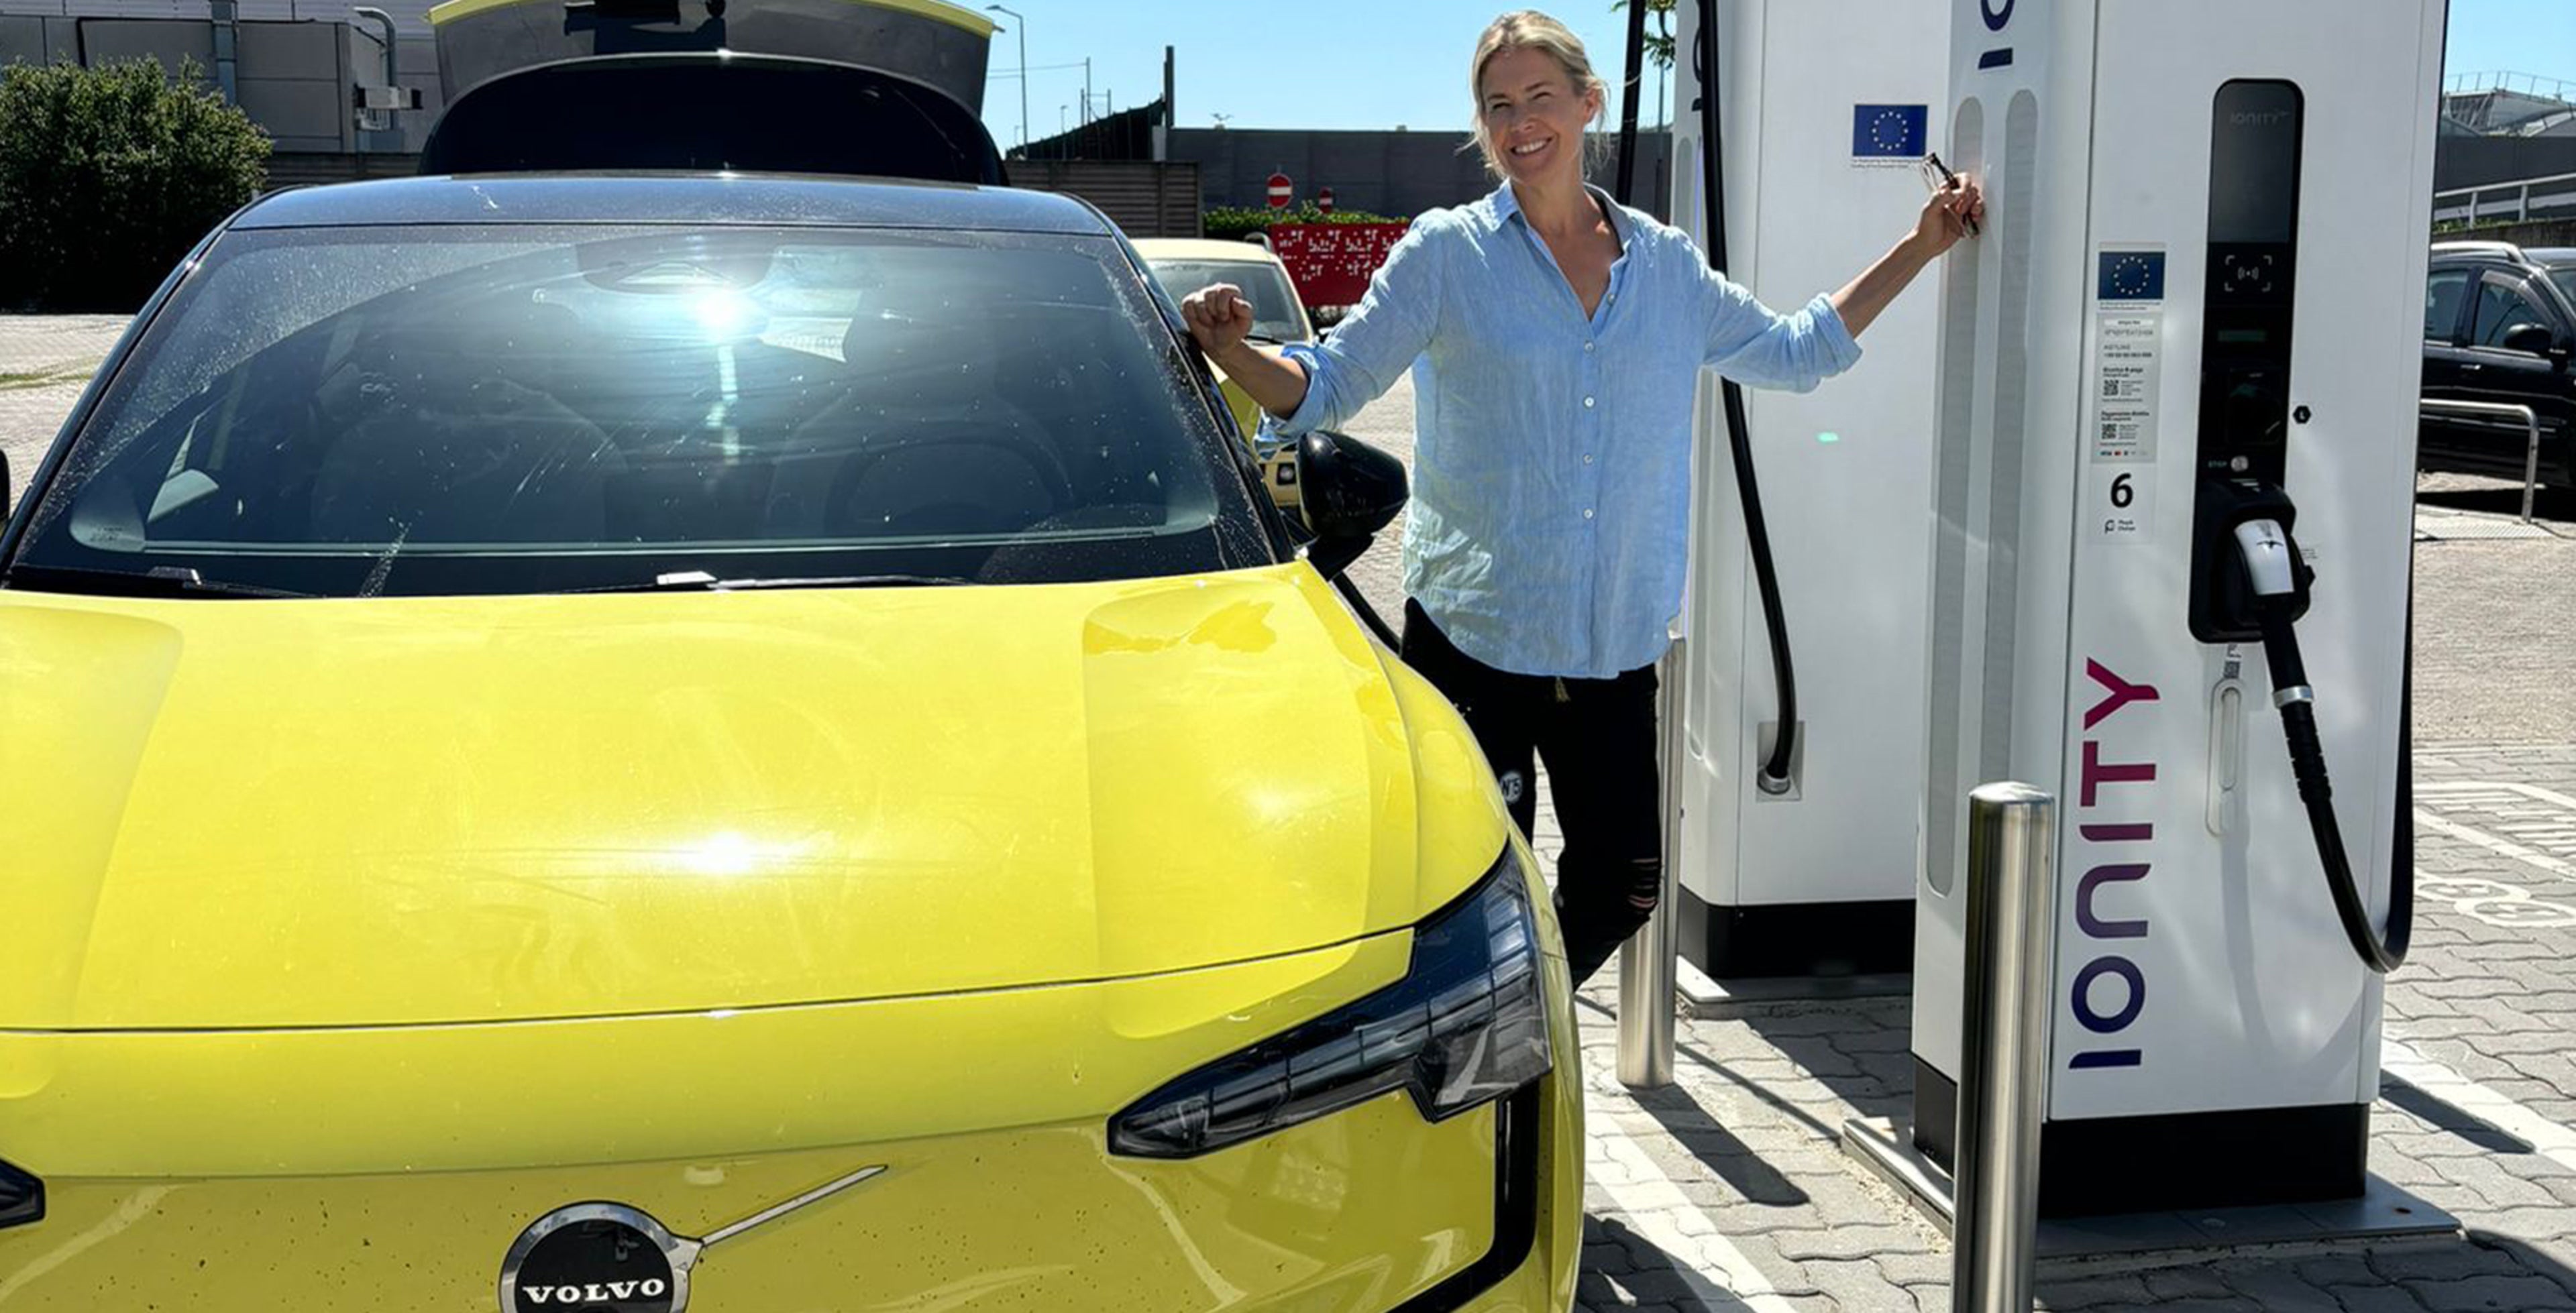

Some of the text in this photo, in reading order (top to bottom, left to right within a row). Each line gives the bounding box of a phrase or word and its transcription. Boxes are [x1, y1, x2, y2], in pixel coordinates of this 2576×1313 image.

[2110, 473, 2133, 508] 6
[2069, 656, 2160, 1070] IONITY
[522, 1277, 665, 1304] VOLVO
